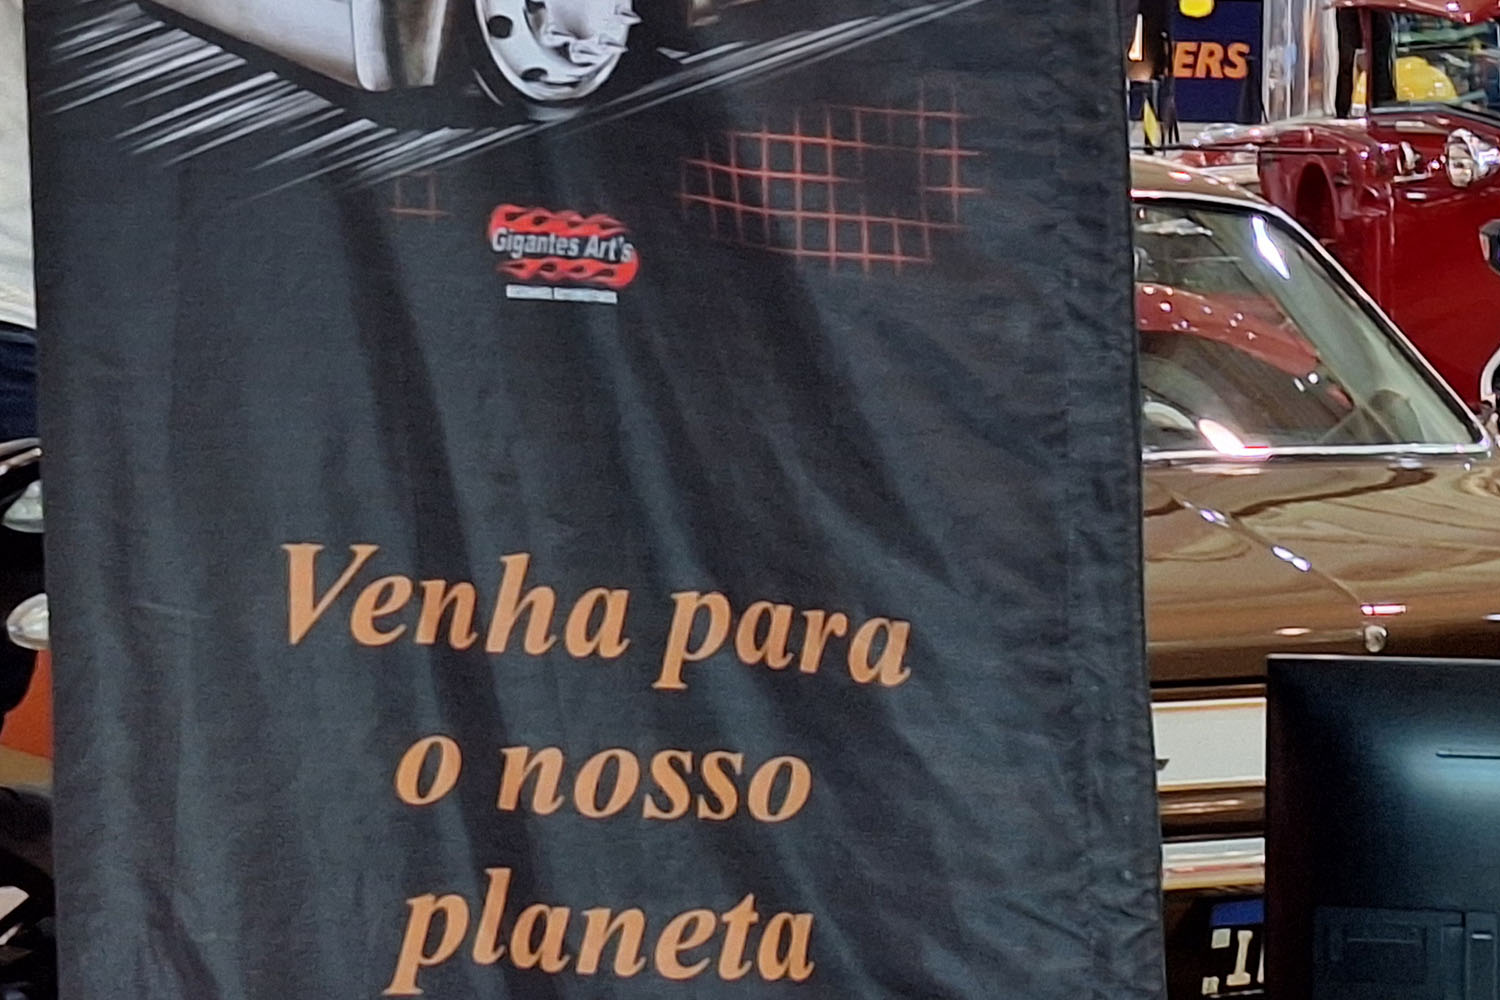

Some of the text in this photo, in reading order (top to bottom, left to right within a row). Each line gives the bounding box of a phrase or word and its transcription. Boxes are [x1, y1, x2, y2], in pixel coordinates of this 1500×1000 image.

[1172, 41, 1251, 79] ERS
[492, 226, 635, 263] Gigantes Art's
[281, 541, 913, 691] Venha para
[395, 734, 814, 824] o nosso
[384, 867, 816, 997] planeta
